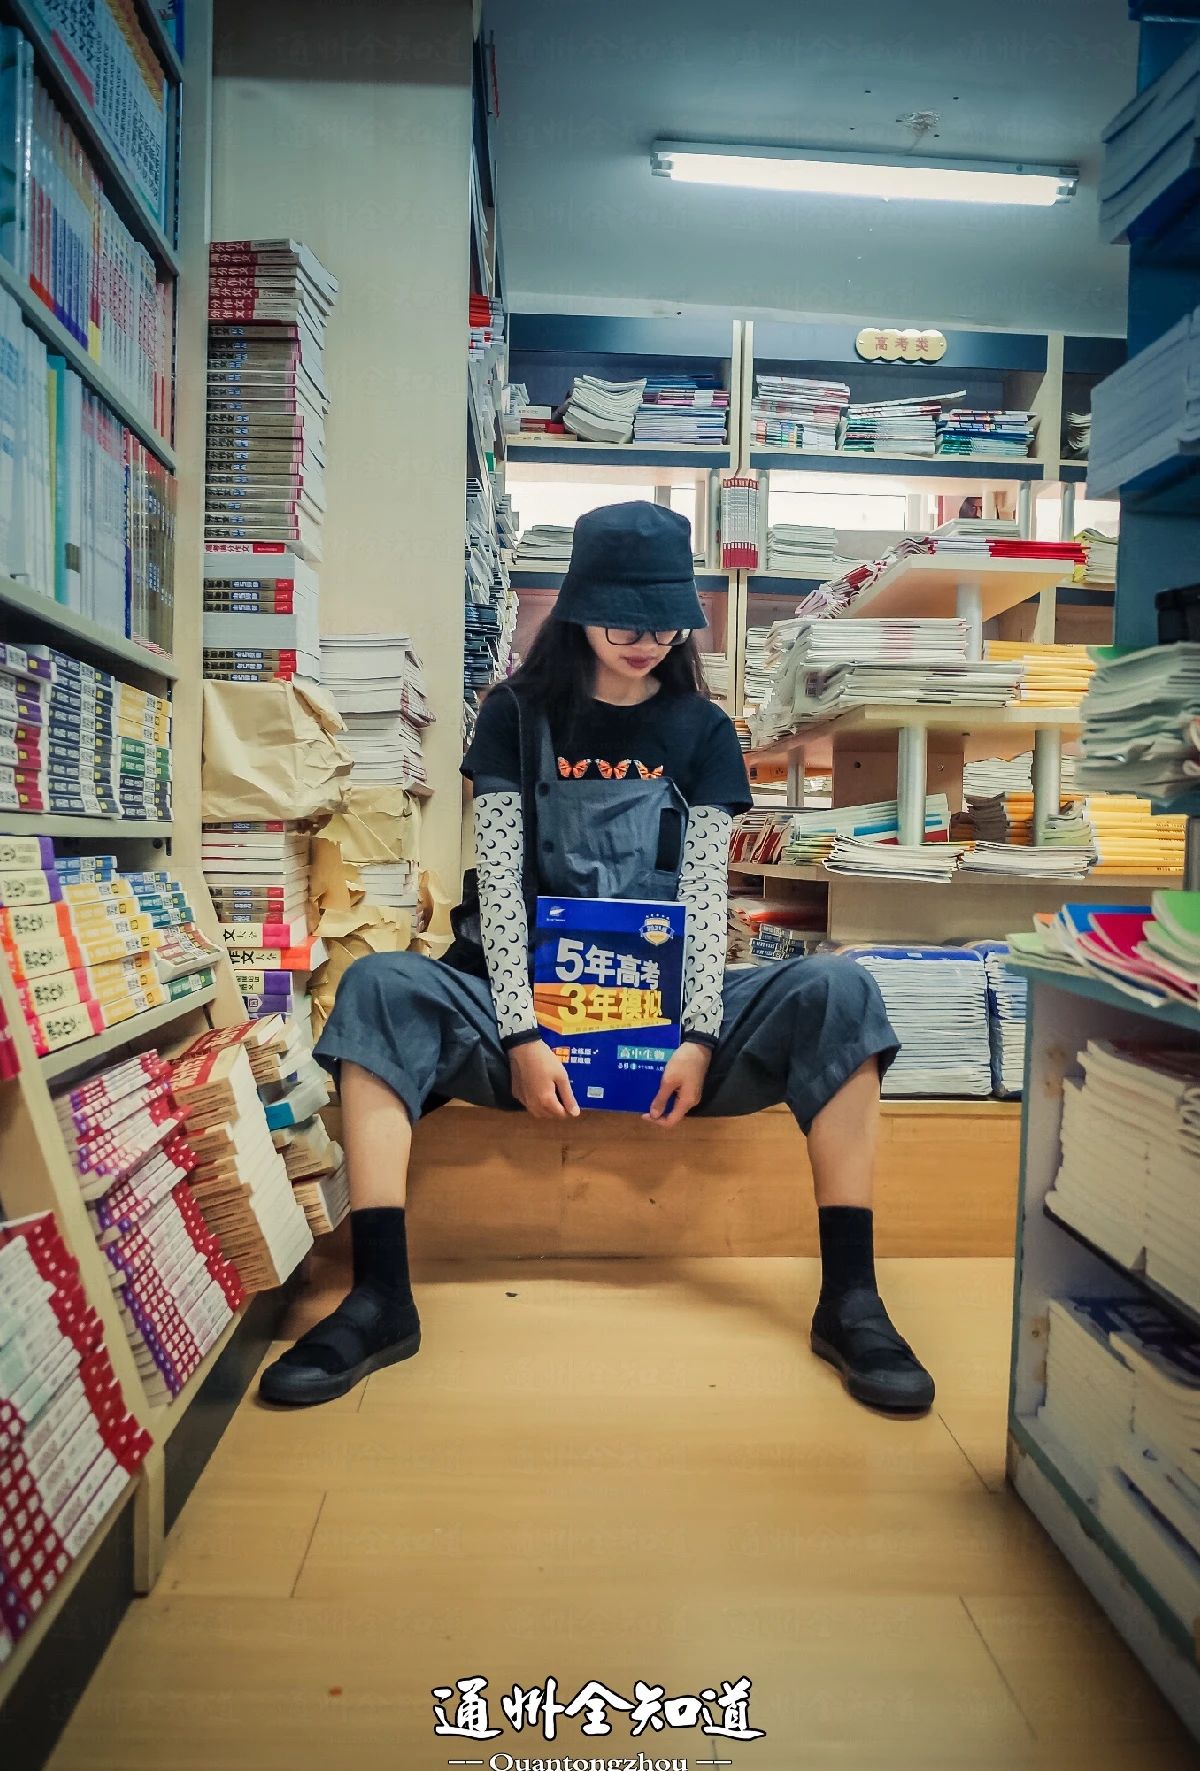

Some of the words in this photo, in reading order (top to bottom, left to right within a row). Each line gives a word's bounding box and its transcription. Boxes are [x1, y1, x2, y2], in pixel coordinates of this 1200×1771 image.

[874, 335, 927, 352] 高考类
[555, 937, 660, 990] 5年高考
[557, 982, 662, 1022] 3年模拟
